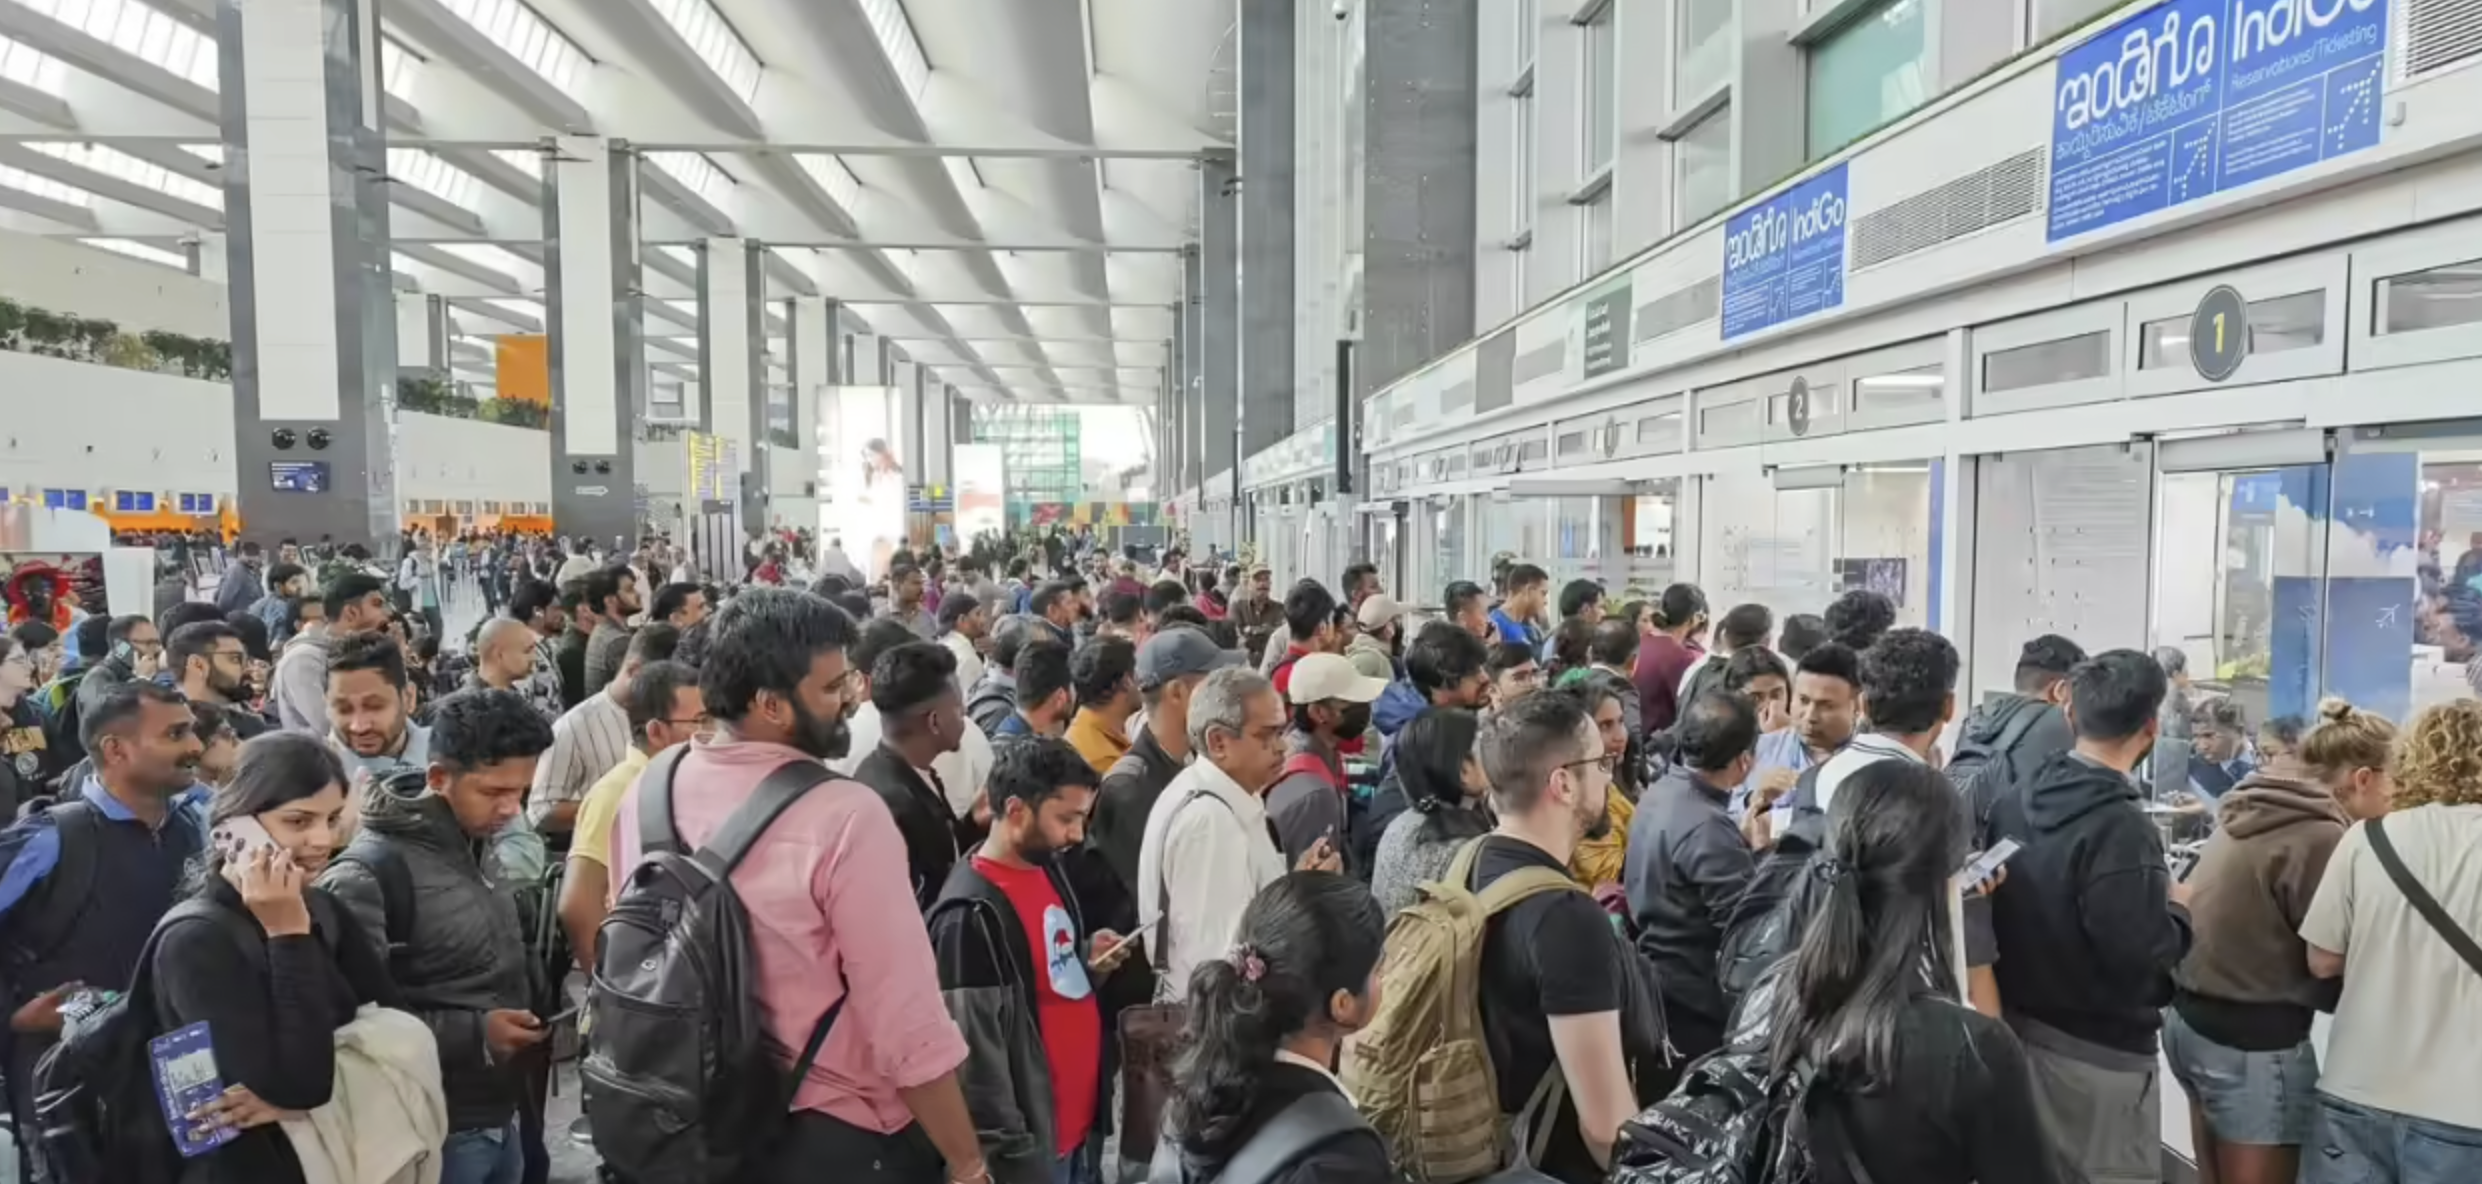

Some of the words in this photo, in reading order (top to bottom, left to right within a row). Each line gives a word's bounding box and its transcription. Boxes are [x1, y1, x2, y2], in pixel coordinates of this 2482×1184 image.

[2232, 0, 2375, 63] Indi
[1791, 191, 1845, 245] IndiGo
[2213, 312, 2225, 353] 1
[1795, 394, 1803, 420] 2
